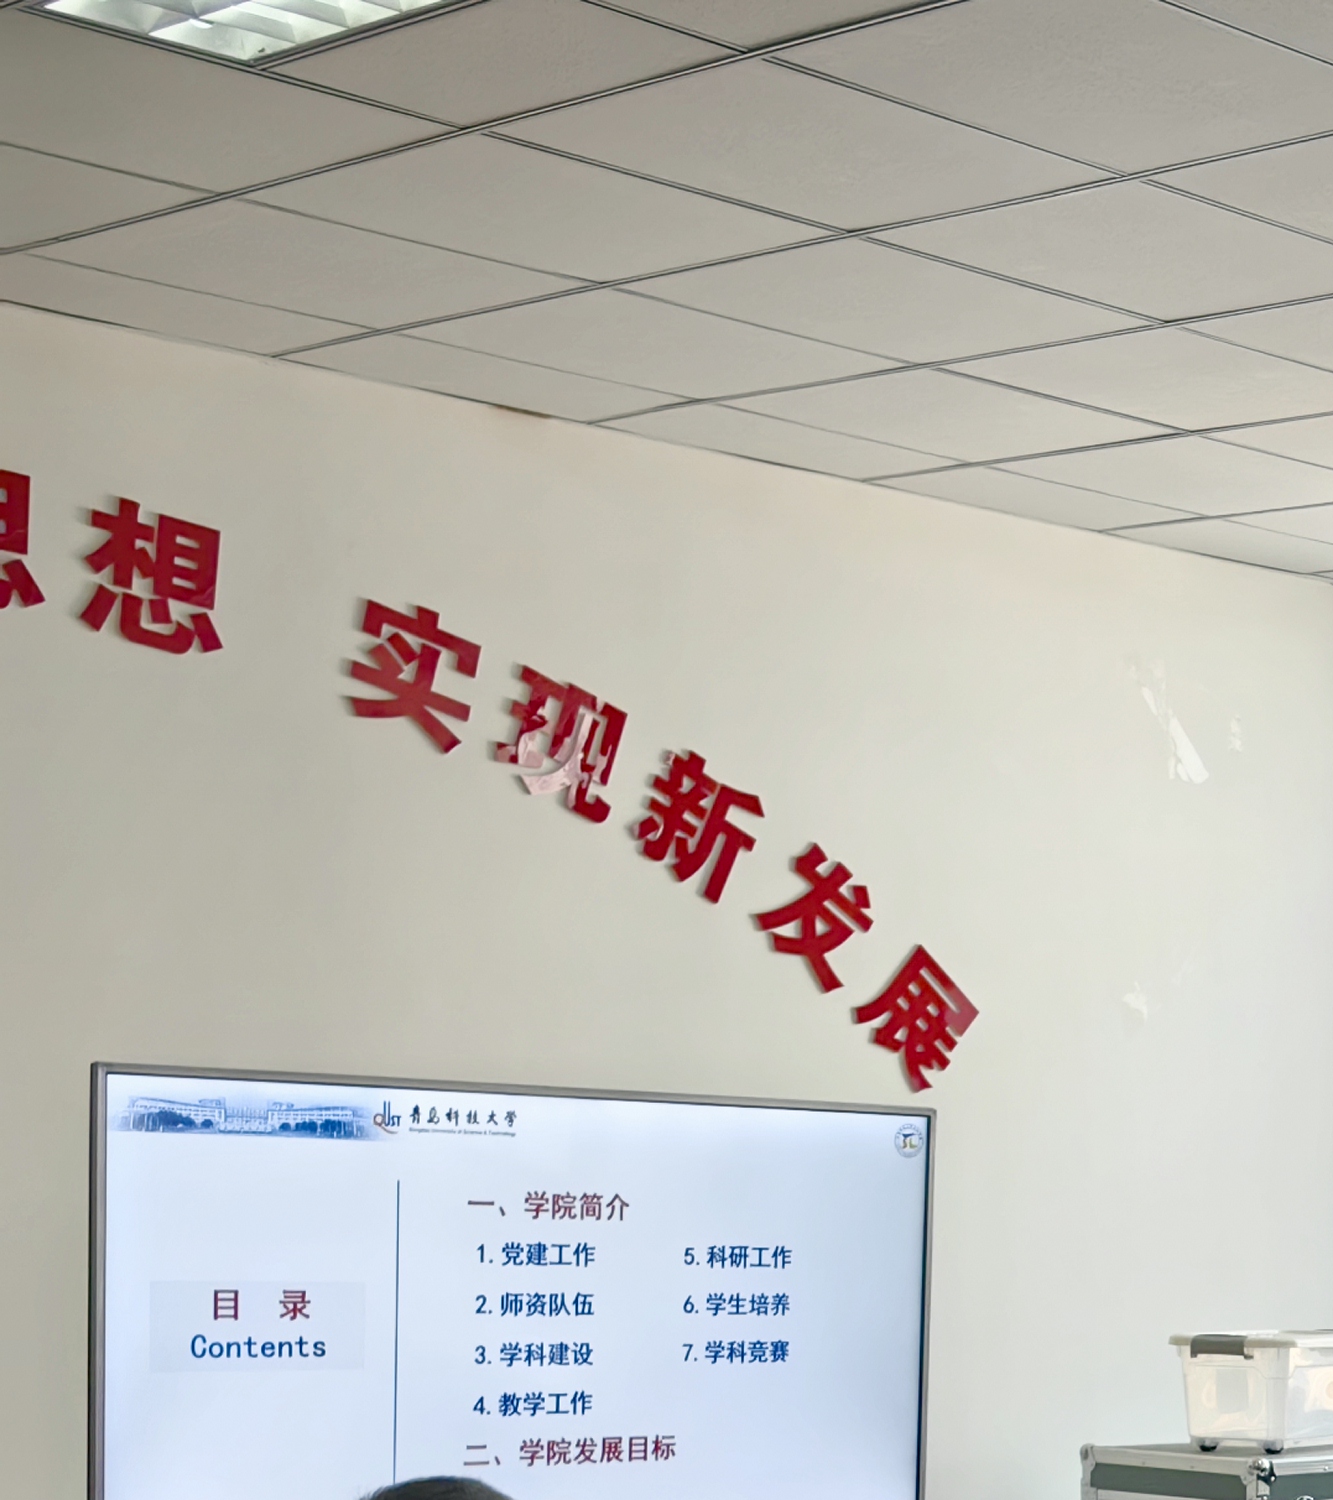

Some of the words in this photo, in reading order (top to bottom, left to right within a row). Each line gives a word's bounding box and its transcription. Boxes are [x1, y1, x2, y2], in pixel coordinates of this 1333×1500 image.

[344, 599, 980, 1092] 实现新发展
[467, 1191, 630, 1221] 一、学院简介
[190, 1333, 326, 1358] Contents
[464, 1435, 676, 1466] 二、学院发展目标
